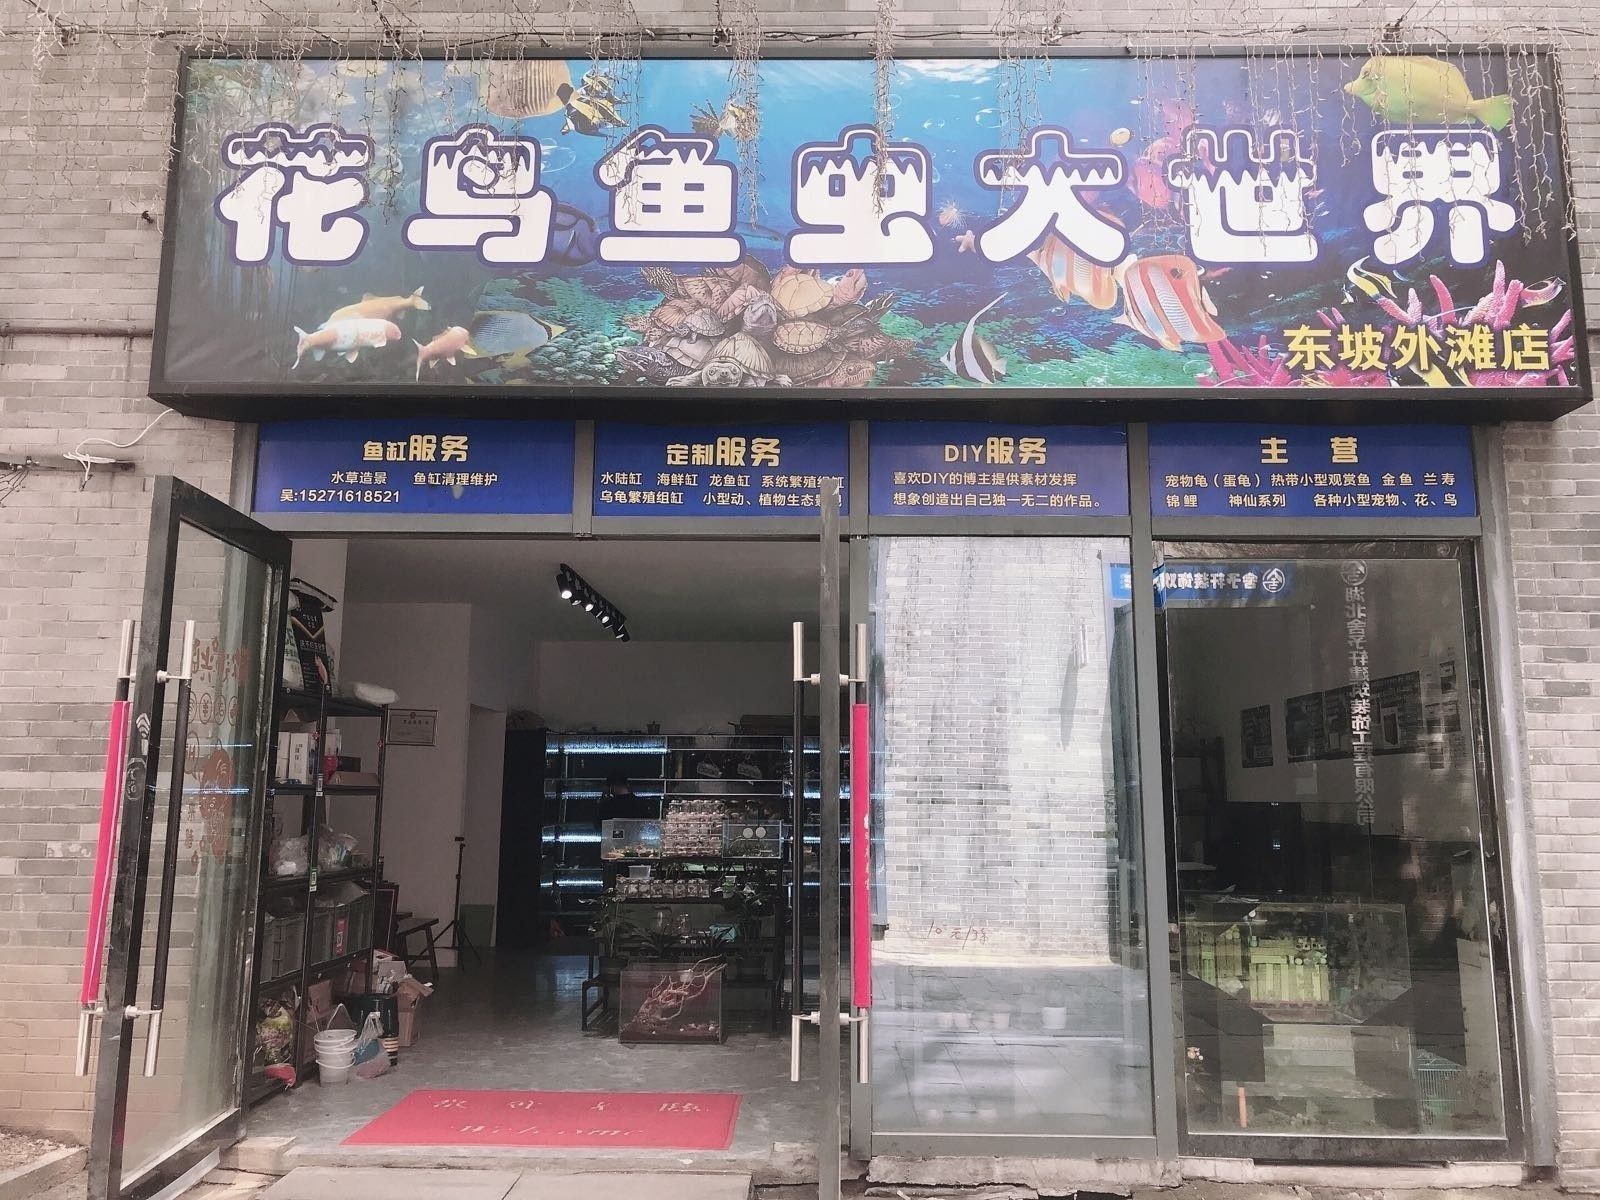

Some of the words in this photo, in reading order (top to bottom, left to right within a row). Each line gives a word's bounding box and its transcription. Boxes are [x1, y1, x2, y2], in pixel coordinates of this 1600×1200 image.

[214, 121, 1516, 268] 花鸟鱼虫大世界
[1284, 324, 1551, 373] 东坡外滩店
[362, 434, 469, 464] 鱼缸服务
[666, 436, 781, 467] 定制服务
[944, 436, 1048, 465] DIY服务
[330, 470, 388, 486] 水草造景
[413, 471, 499, 487] 鱼缸清理维护
[600, 471, 643, 486] 水陆缸
[656, 472, 699, 488] 海鲜缸
[709, 473, 752, 488] 龙鱼缸
[893, 471, 1077, 487] 喜欢DIY的博主提供素材发挥
[1270, 472, 1371, 488] 热带小型观赏鱼
[279, 489, 400, 504] 吴:15271618521
[599, 490, 684, 505] 乌龟繁殖组缸
[702, 491, 842, 507] 小型动、植物生态
[893, 491, 1102, 508] 想象创造出自己独一无二的作品。
[1228, 493, 1286, 508] 神仙系列
[1313, 492, 1458, 508] 各种小型宠物、花、鸟
